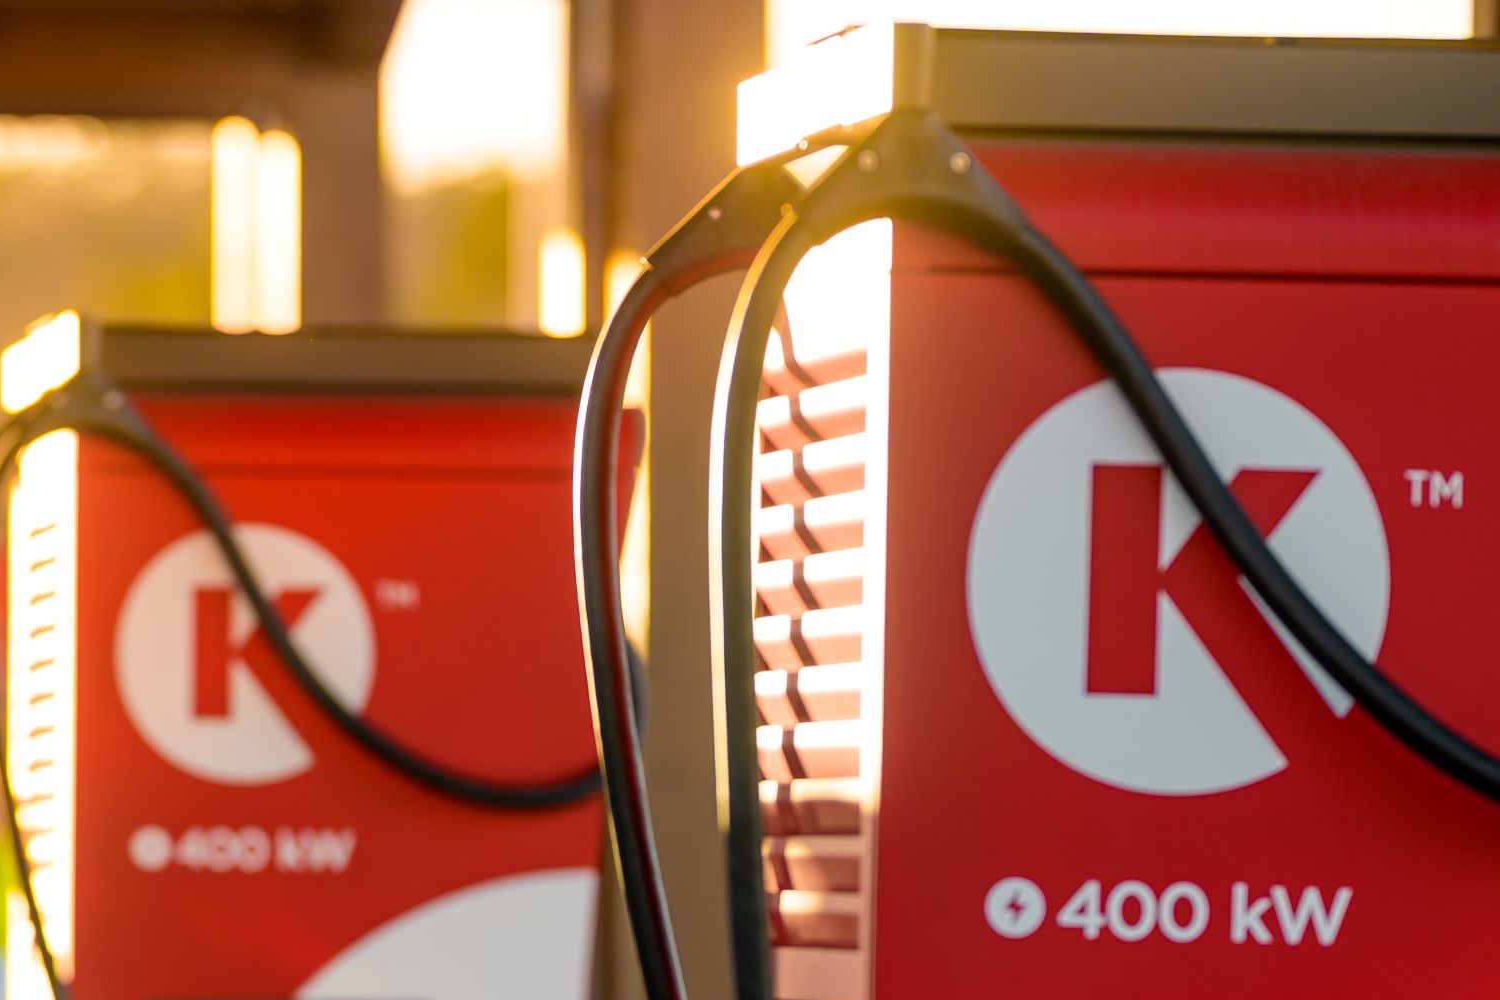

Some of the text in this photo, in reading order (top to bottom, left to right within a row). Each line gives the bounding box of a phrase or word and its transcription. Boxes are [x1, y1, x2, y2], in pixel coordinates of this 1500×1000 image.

[1403, 469, 1464, 510] TM
[174, 824, 272, 875] 400
[1056, 878, 1354, 947] 400 kW
